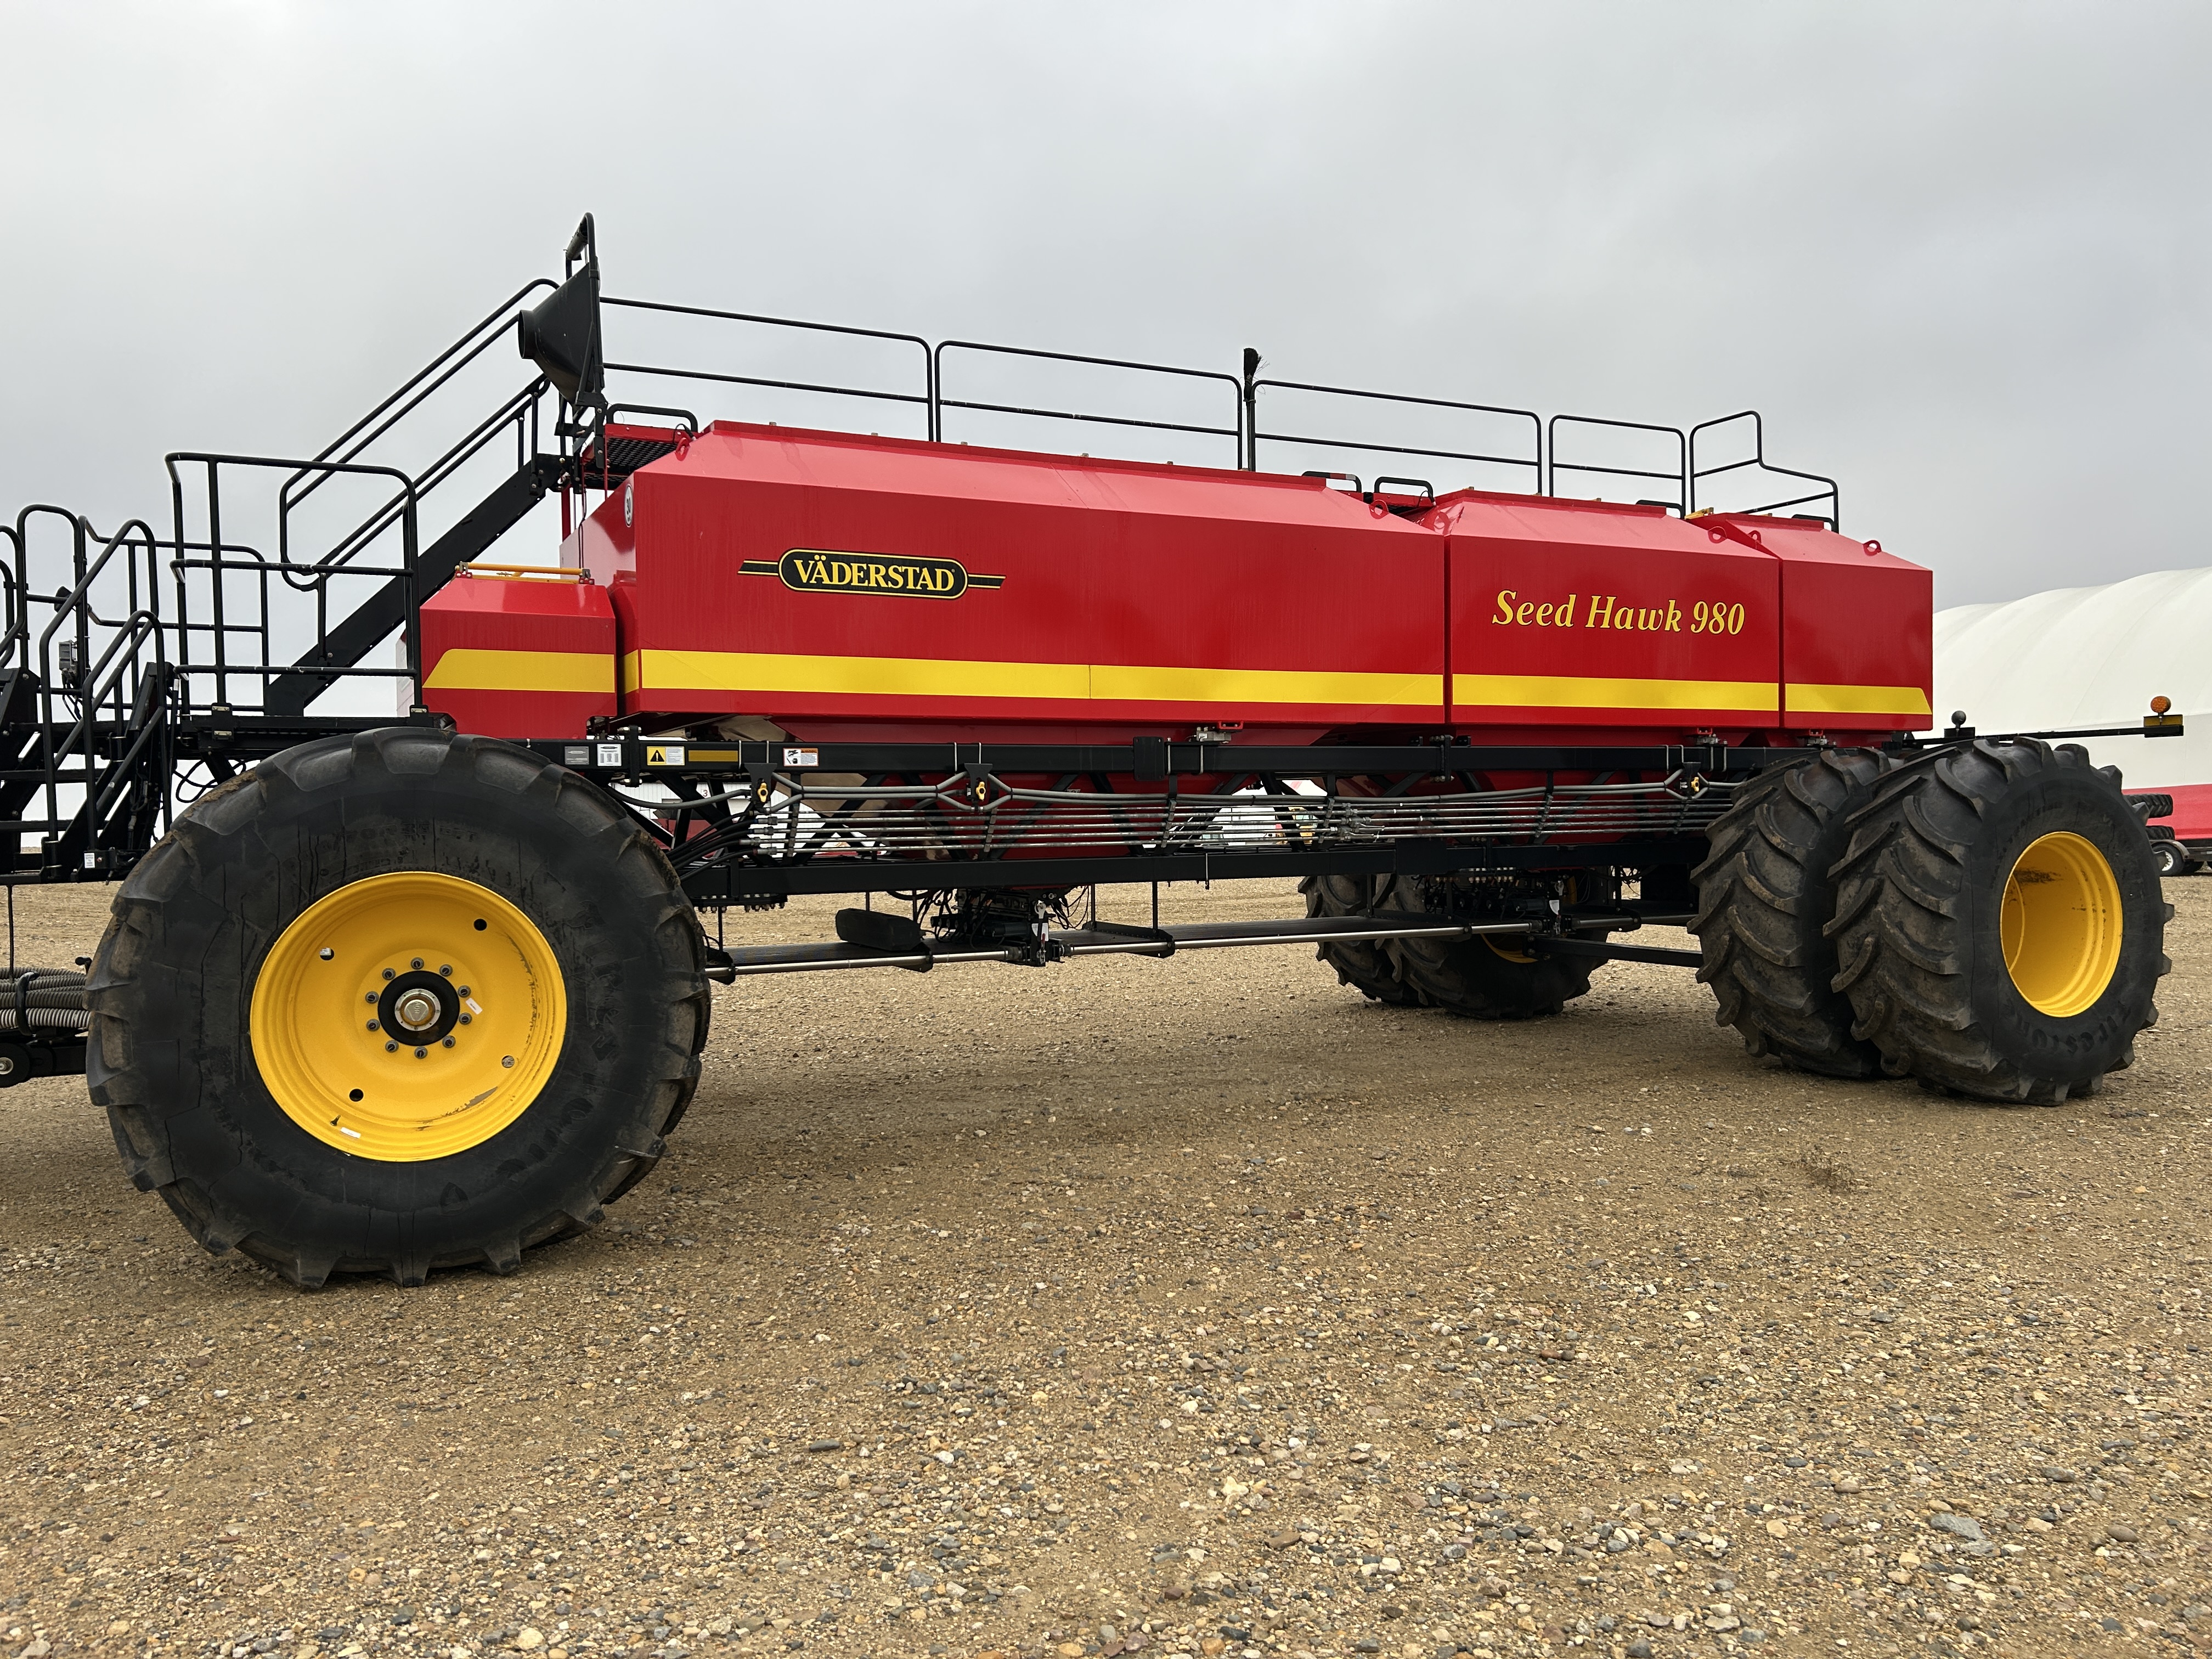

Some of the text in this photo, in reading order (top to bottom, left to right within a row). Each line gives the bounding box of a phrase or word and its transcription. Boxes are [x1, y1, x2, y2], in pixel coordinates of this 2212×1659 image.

[793, 554, 954, 592] VÄDERSTAD
[1492, 589, 1745, 635] Seed Hawk 980
